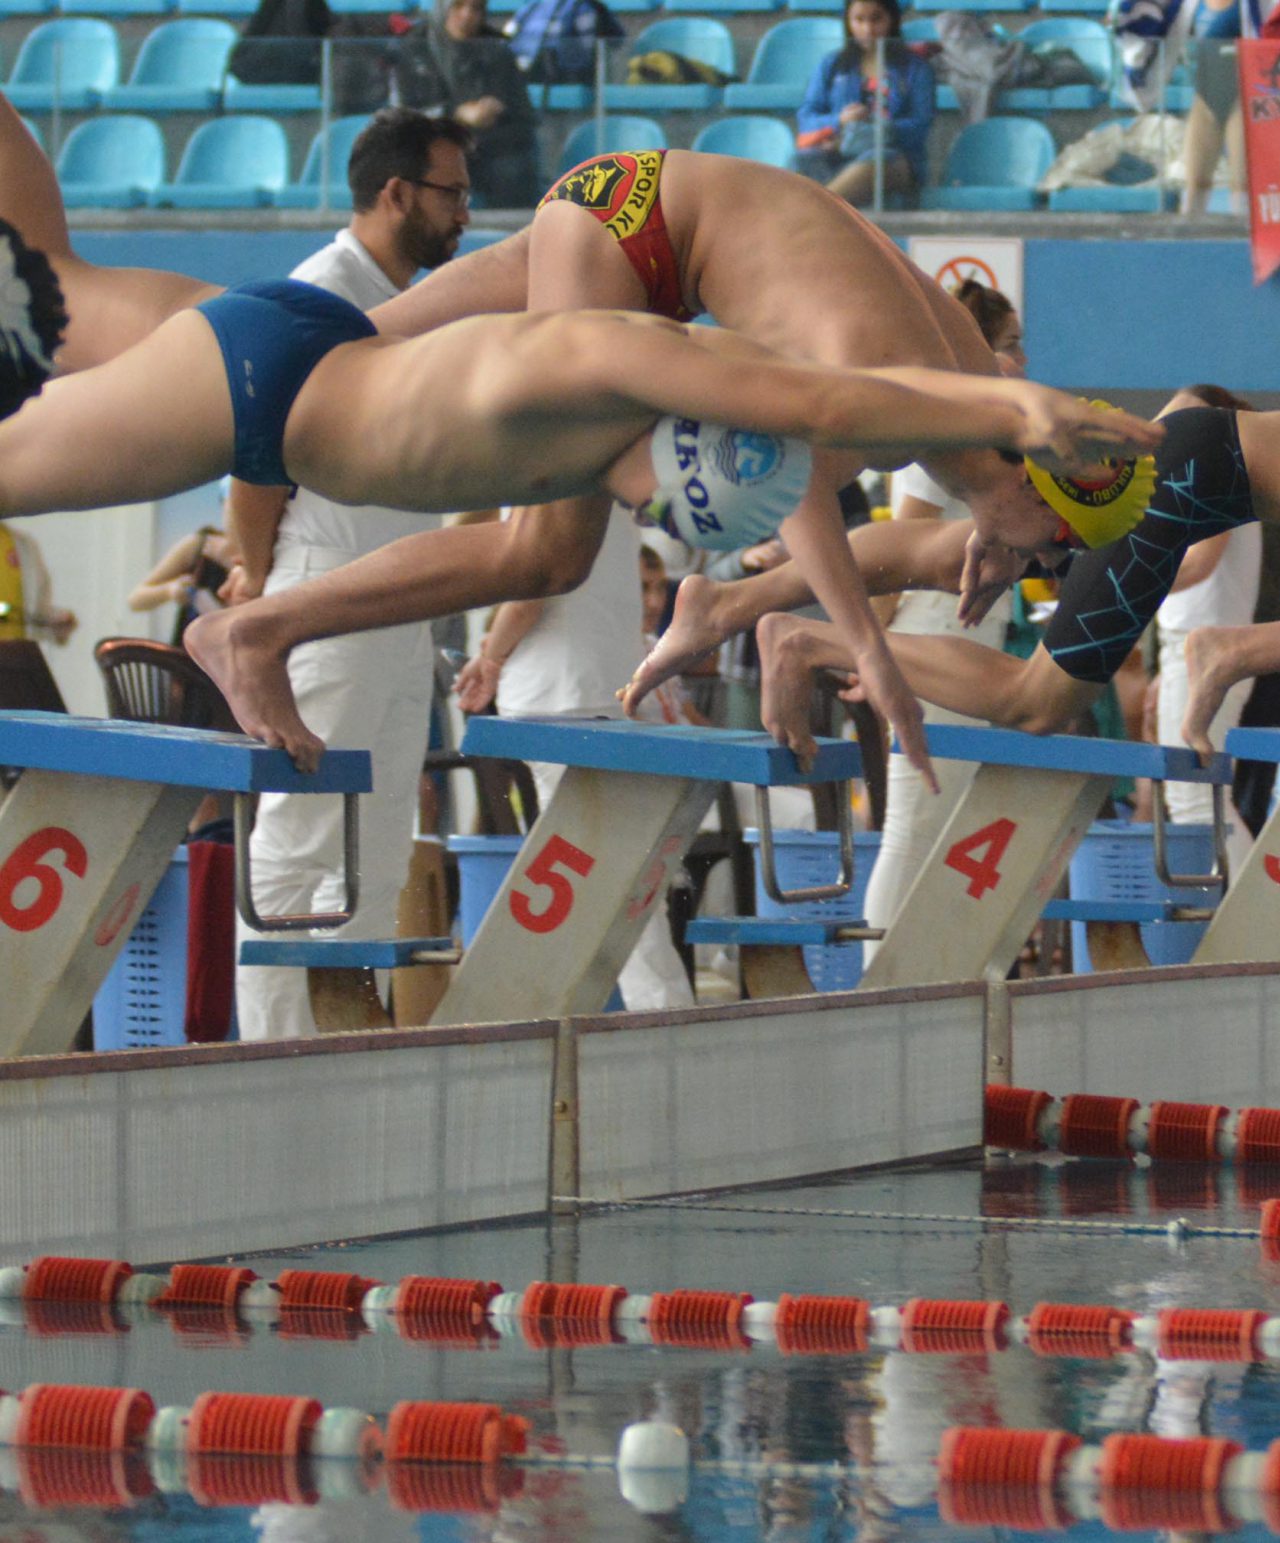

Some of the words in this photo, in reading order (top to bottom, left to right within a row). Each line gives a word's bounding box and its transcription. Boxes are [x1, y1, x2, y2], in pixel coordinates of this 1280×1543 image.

[629, 156, 657, 209] SPOR
[0, 826, 88, 932] 6
[509, 834, 596, 933] 5
[944, 817, 1017, 900] 4
